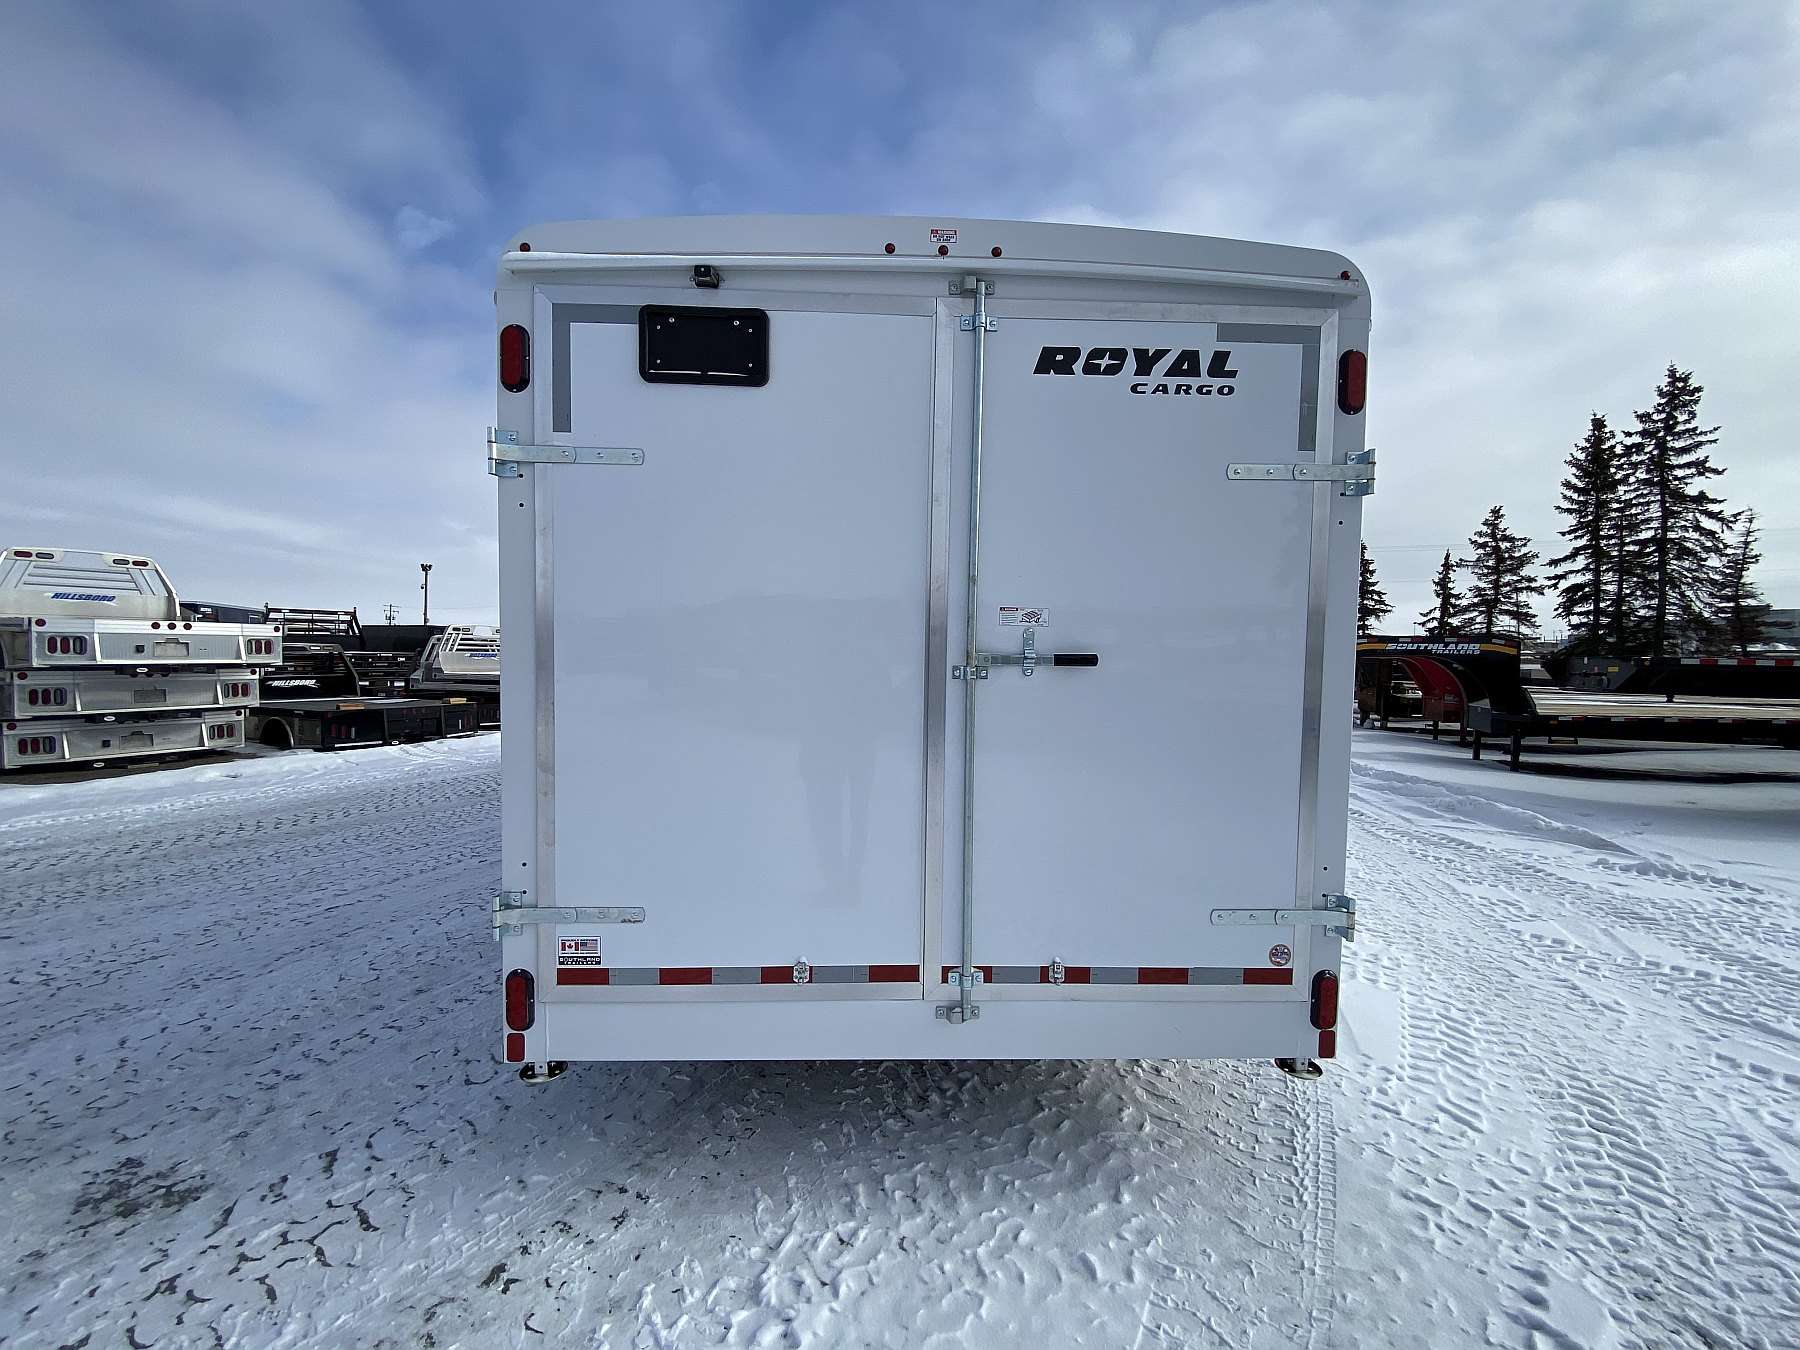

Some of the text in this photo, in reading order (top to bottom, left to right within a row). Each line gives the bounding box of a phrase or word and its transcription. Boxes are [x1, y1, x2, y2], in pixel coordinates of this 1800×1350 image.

[1033, 346, 1239, 379] ROYAL
[1130, 383, 1235, 397] CARGO
[51, 592, 116, 602] HILLSBORO
[271, 679, 317, 687] HILLSBORO
